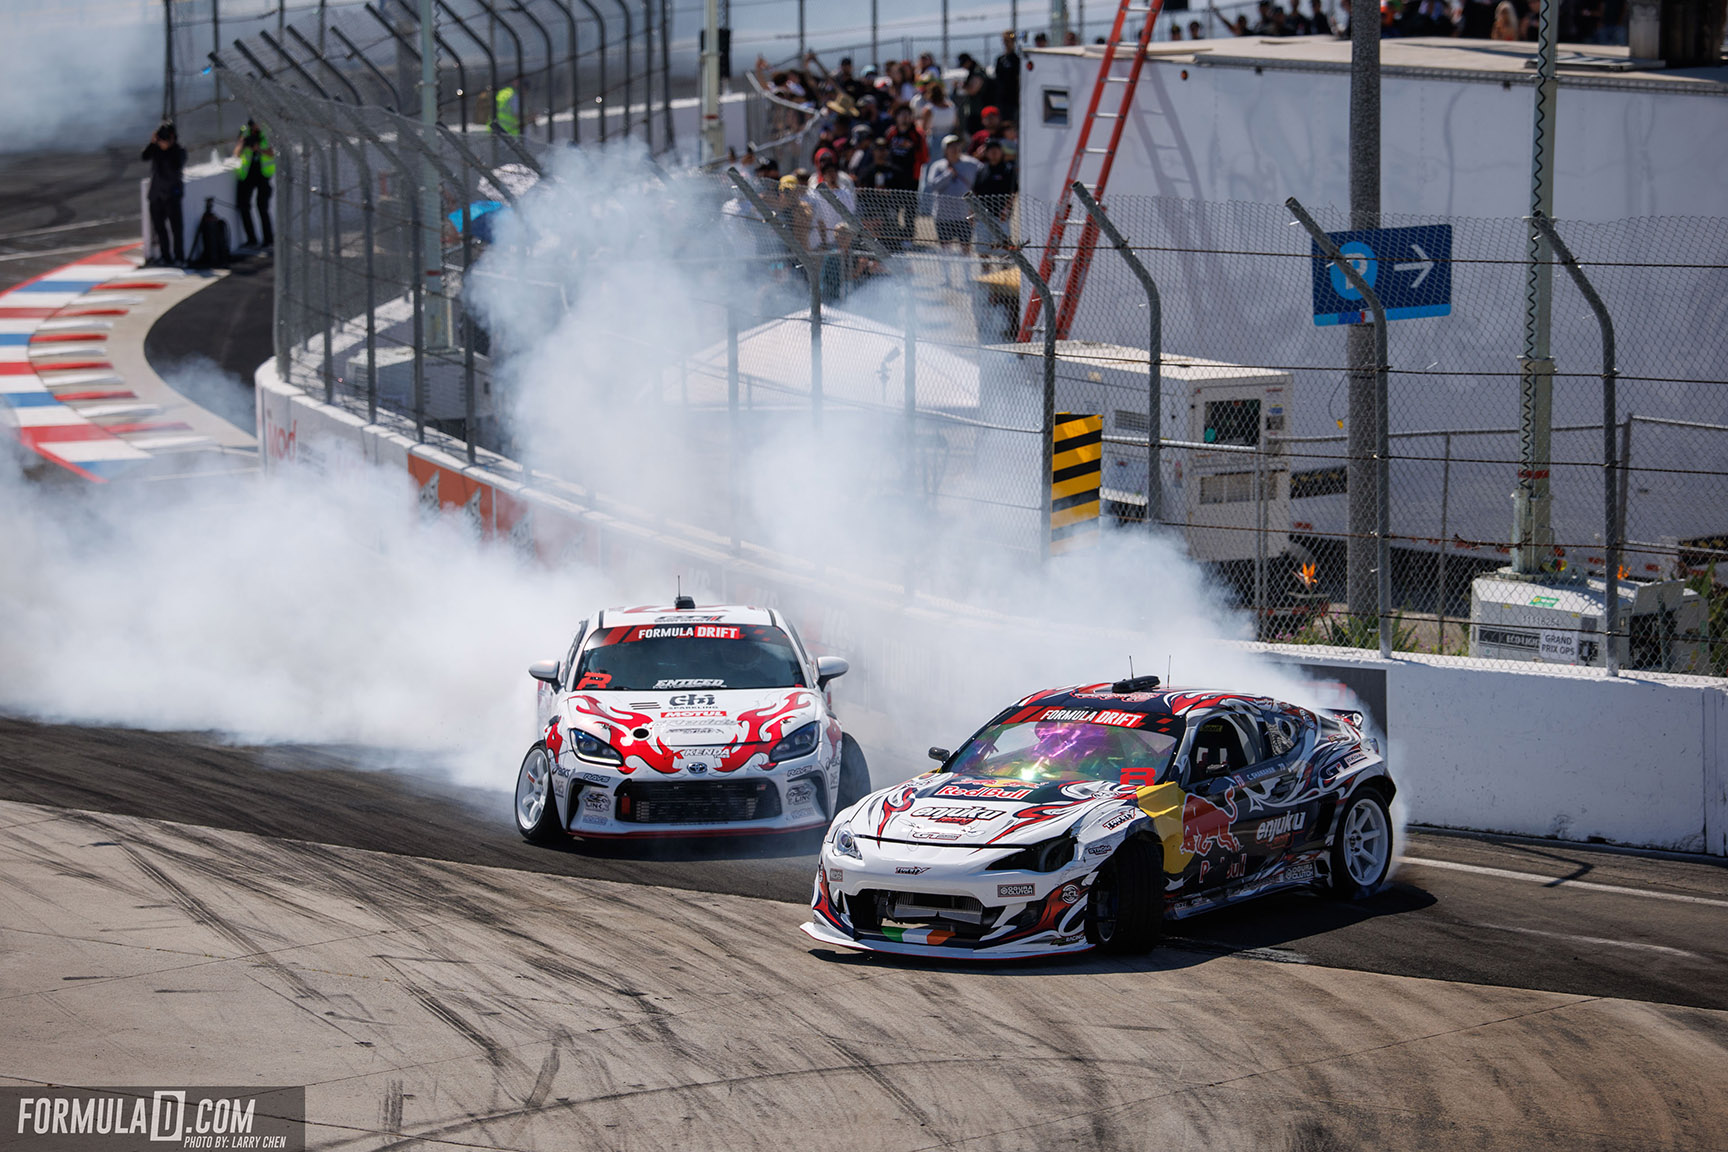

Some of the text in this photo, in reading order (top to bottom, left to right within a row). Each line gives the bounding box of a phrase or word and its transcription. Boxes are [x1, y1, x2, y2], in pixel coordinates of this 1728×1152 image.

[638, 627, 737, 639] FORMULA DRIFT
[1506, 635, 1540, 647] ECO-LIGH
[1545, 634, 1572, 645] GRAND
[1542, 644, 1575, 656] PRIX OPS
[576, 672, 612, 689] R
[655, 679, 724, 688] ENTICED
[1040, 709, 1142, 727] FORMULA DRIFT
[684, 748, 730, 758] KENDA
[1120, 767, 1156, 786] R
[934, 786, 986, 798] Red
[982, 787, 1033, 799] Bull
[911, 806, 1007, 821] enjuku
[1256, 811, 1306, 842] enjuku
[1291, 870, 1313, 880] CLUTCH
